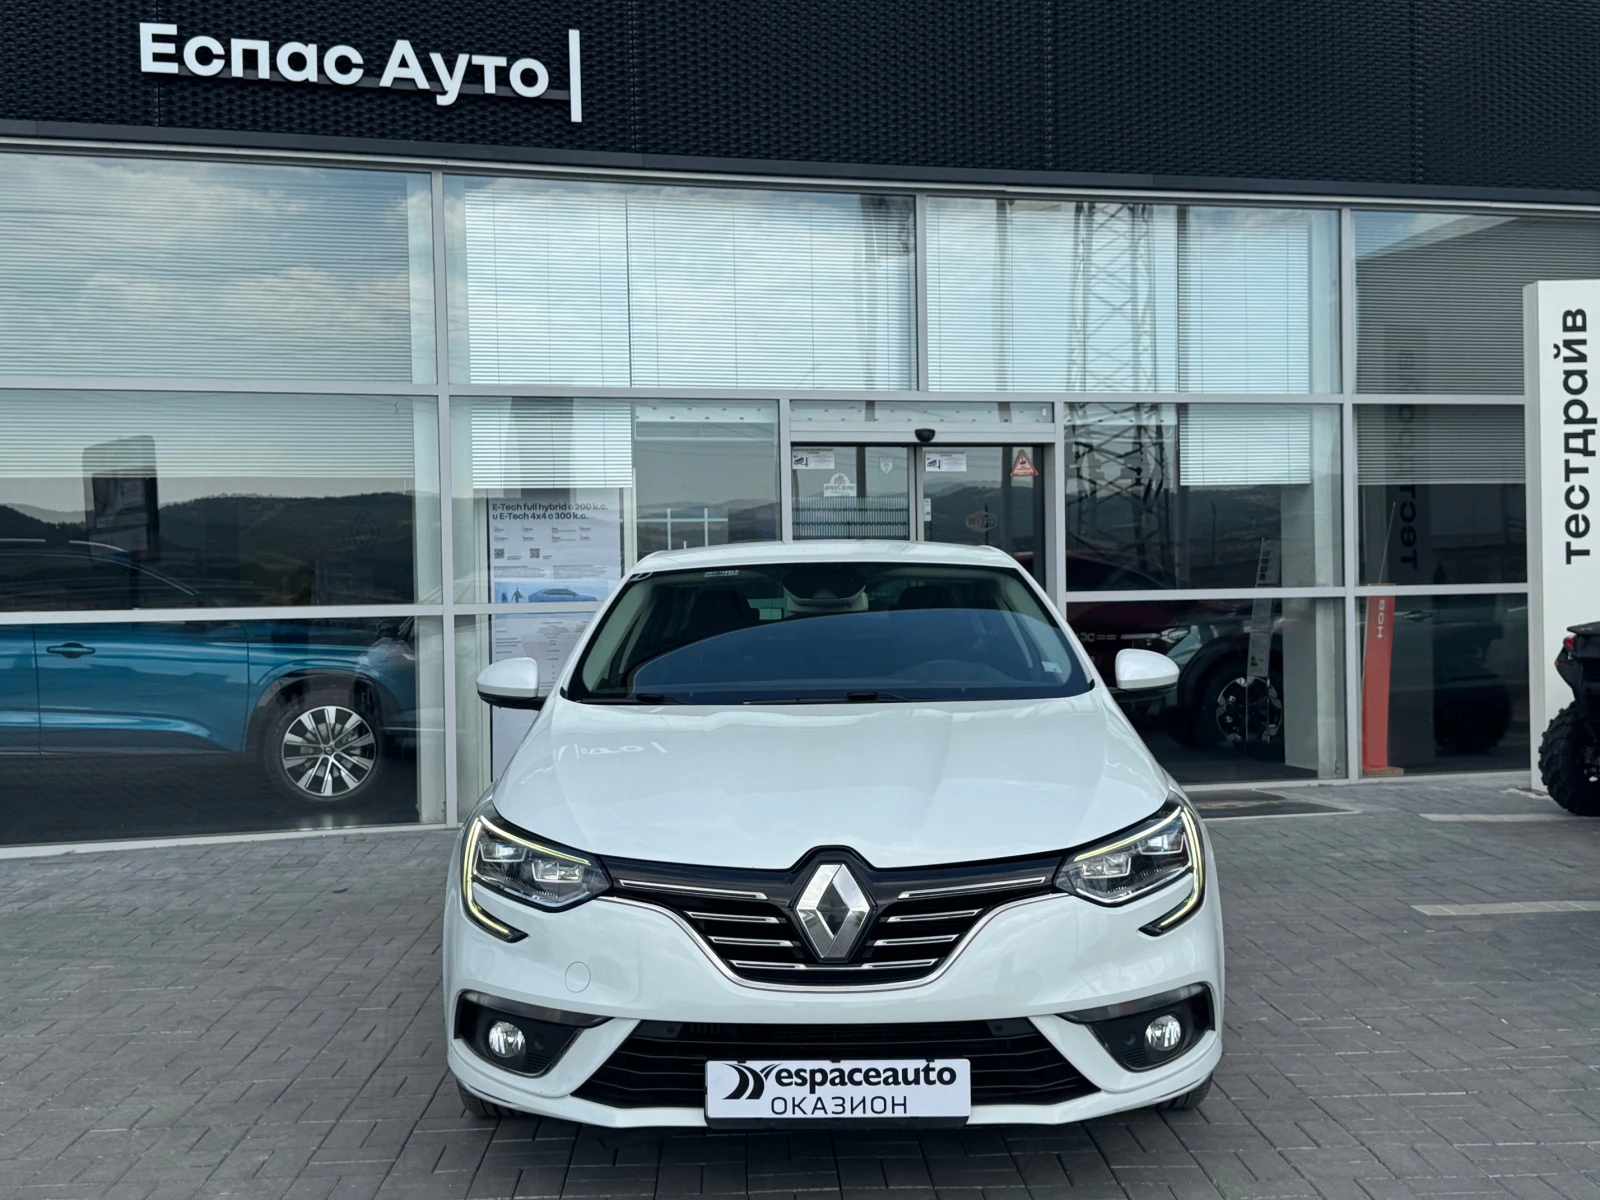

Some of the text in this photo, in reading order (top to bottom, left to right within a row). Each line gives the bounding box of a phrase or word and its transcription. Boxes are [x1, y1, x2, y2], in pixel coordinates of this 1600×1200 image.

[139, 22, 549, 106] Еспас Ауто
[1553, 308, 1598, 565] тестдрайв
[492, 503, 522, 511] E-Tech
[523, 502, 538, 511] full
[539, 502, 567, 512] hybrid
[575, 503, 592, 511] 200
[499, 512, 530, 520] E-Tech
[554, 512, 572, 520] 300
[774, 1062, 957, 1095] espaceauto
[770, 1095, 907, 1116] ОКАЗИОН
